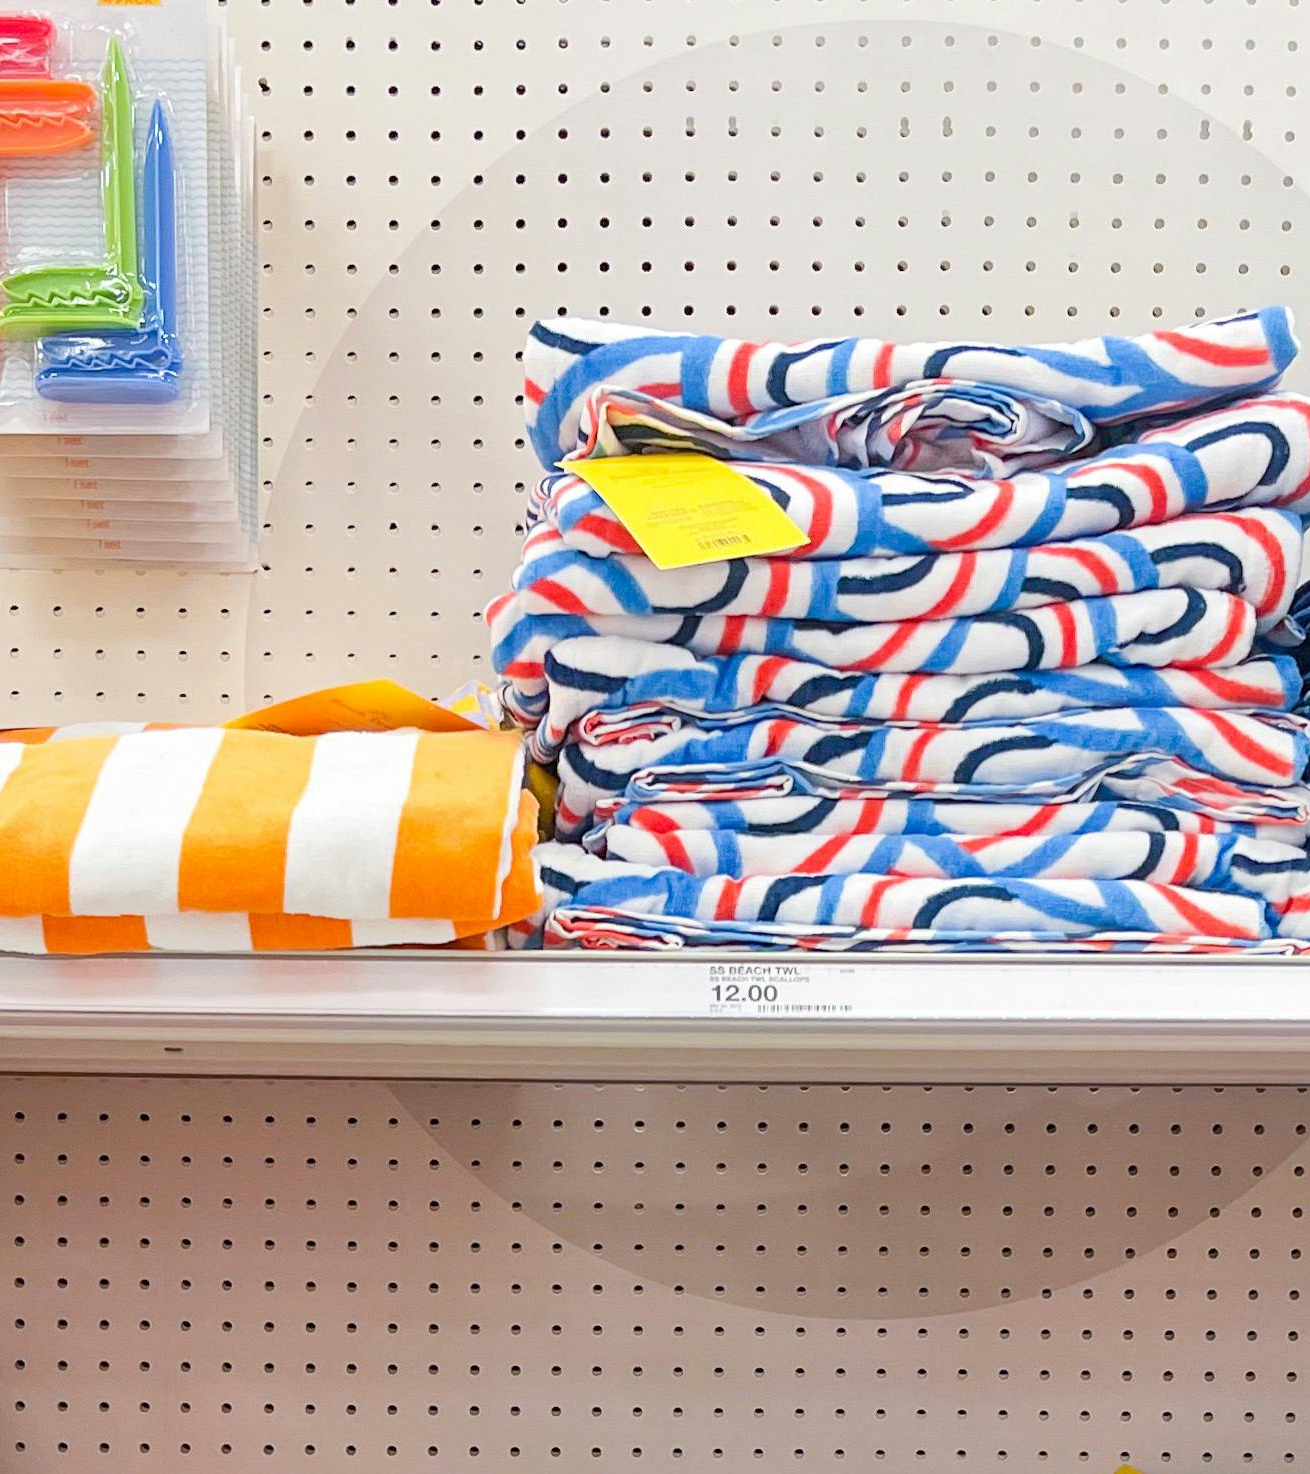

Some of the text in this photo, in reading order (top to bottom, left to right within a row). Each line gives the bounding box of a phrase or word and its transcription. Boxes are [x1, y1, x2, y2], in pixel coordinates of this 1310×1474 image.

[709, 966, 801, 975] SS BEACH TWL
[711, 984, 778, 1002] 12.00
